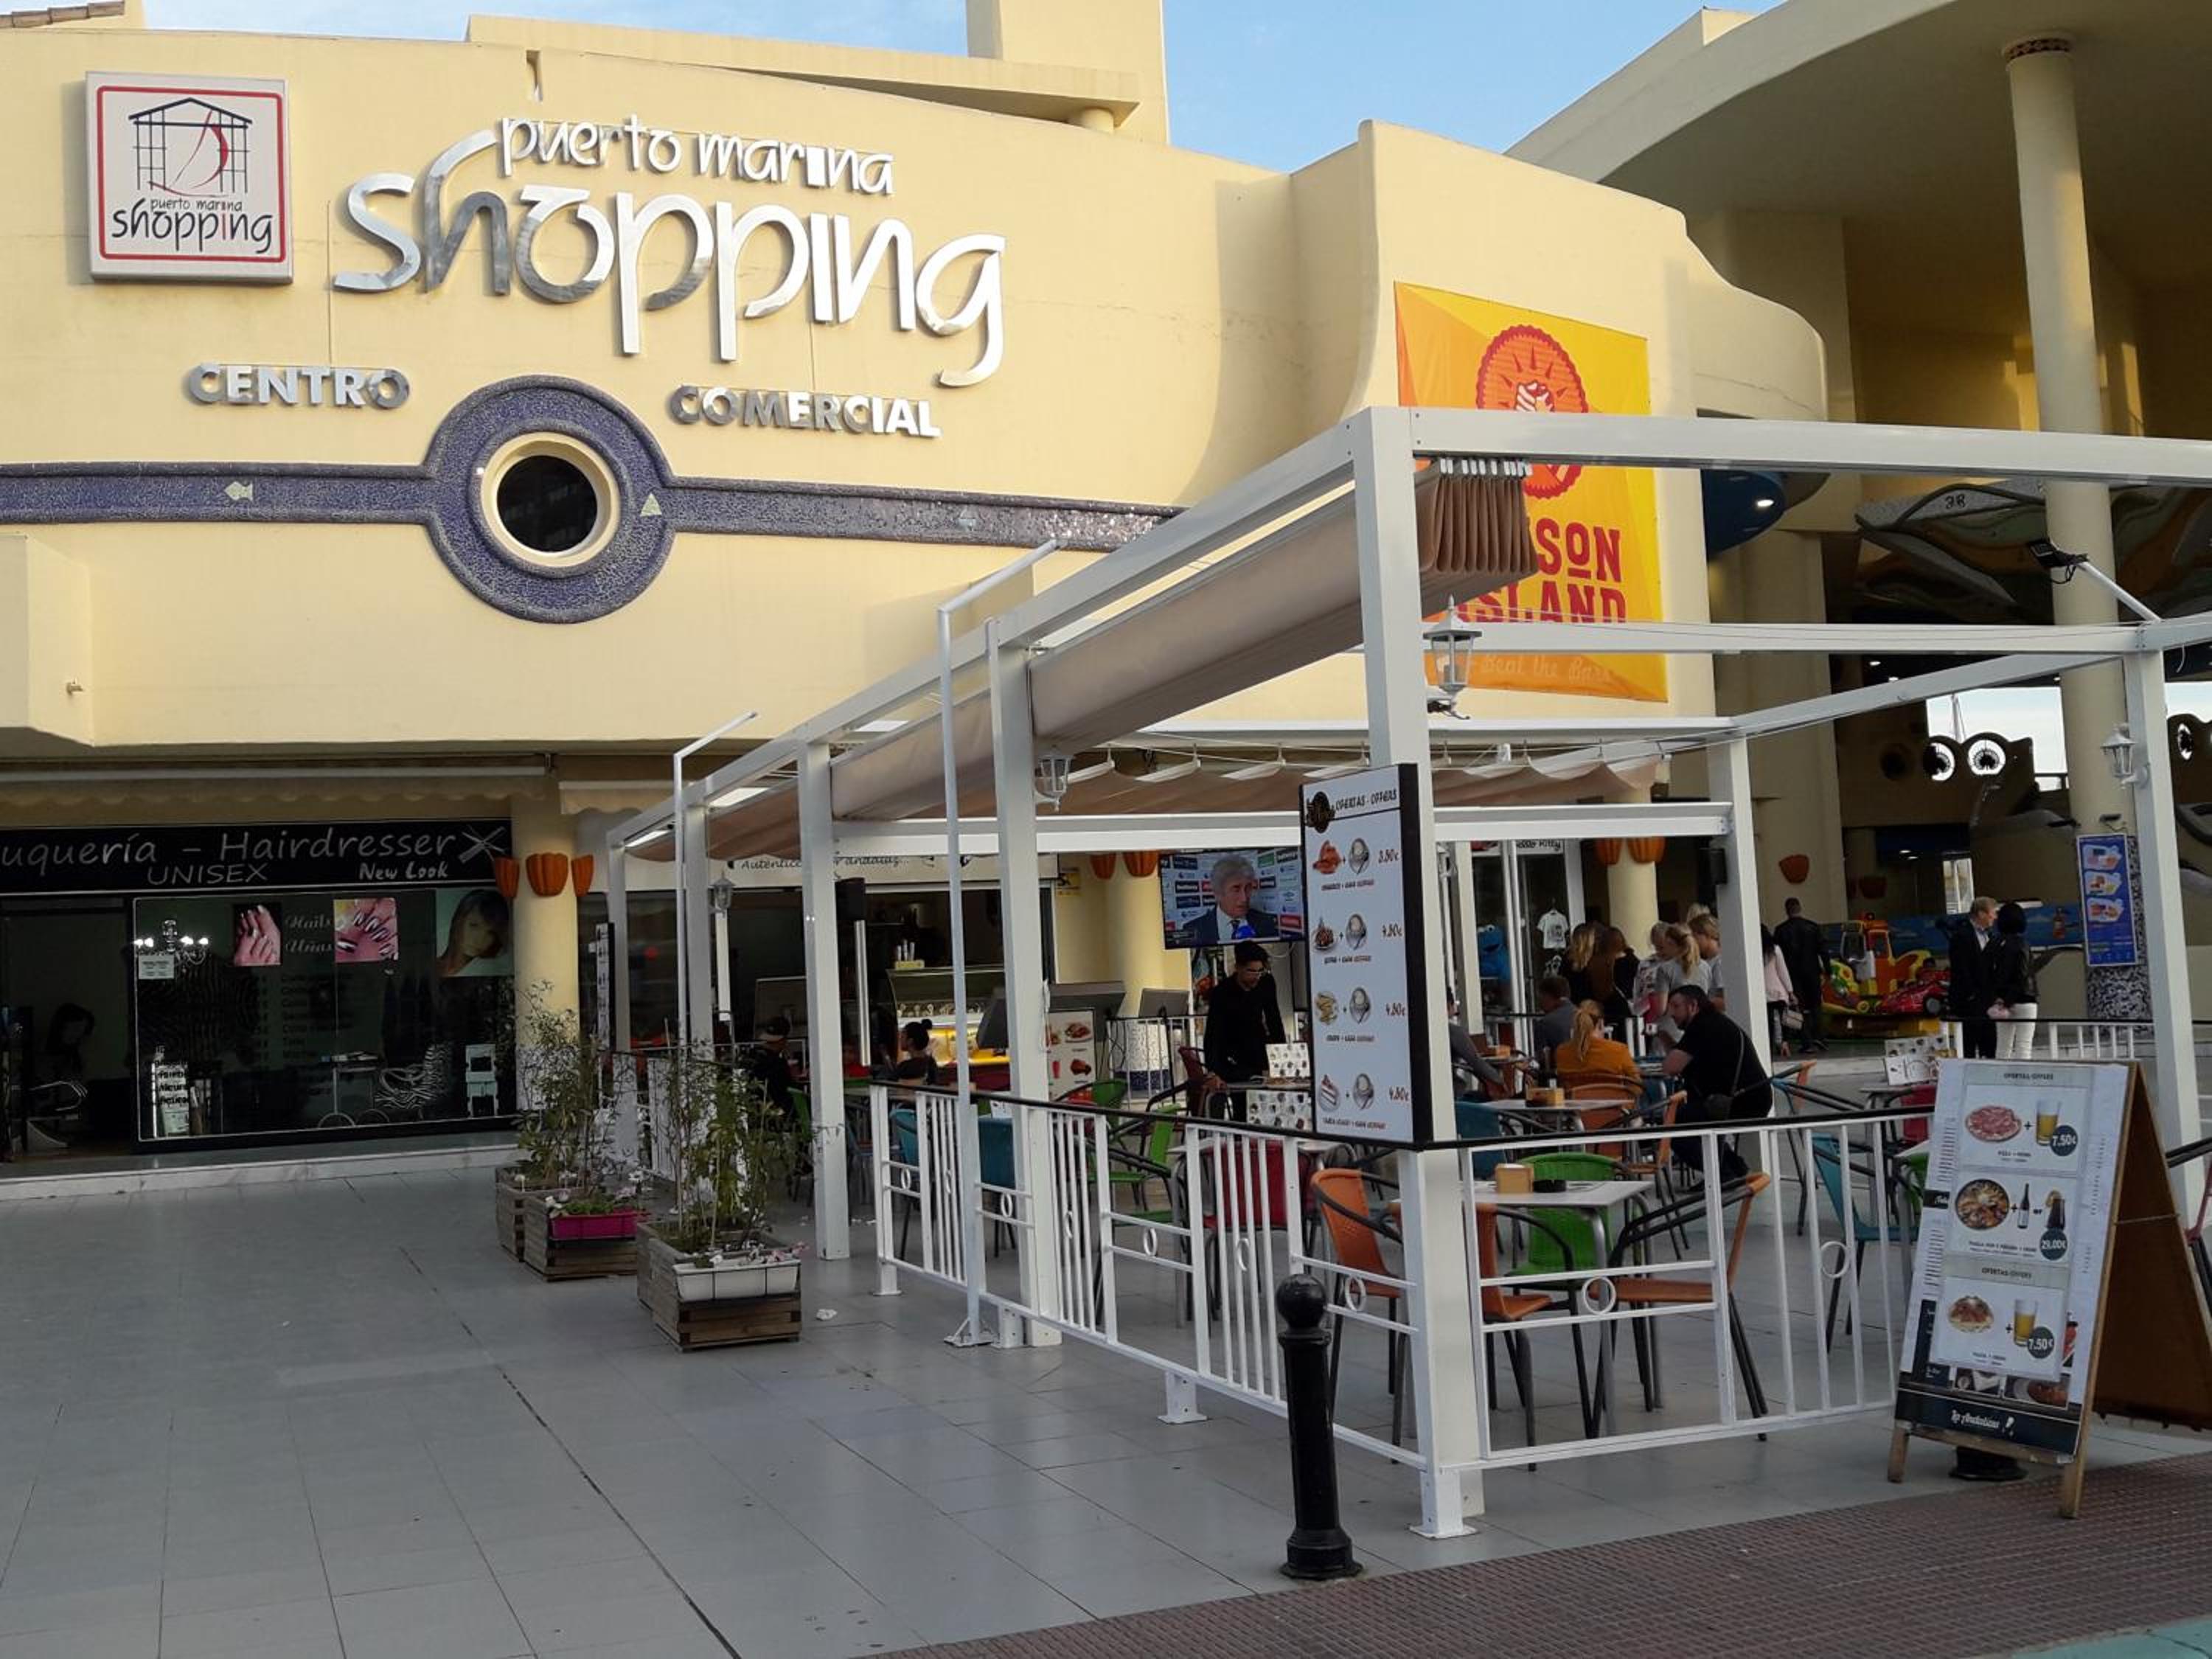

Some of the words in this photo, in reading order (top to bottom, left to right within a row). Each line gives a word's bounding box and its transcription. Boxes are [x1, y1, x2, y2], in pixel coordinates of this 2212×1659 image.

[502, 114, 682, 178] puerto
[698, 133, 894, 195] marina
[150, 198, 191, 213] puerto
[196, 201, 243, 212] marina
[111, 198, 273, 254] shopping
[187, 364, 410, 409] CENTRO
[667, 385, 942, 438] COMERCIAL
[1335, 794, 1366, 812] OFERTAS
[1371, 788, 1398, 804] OFFERS
[220, 826, 456, 864] Hairdresser
[147, 863, 268, 886] UNISEX
[358, 863, 400, 881] New
[406, 861, 449, 879] Look
